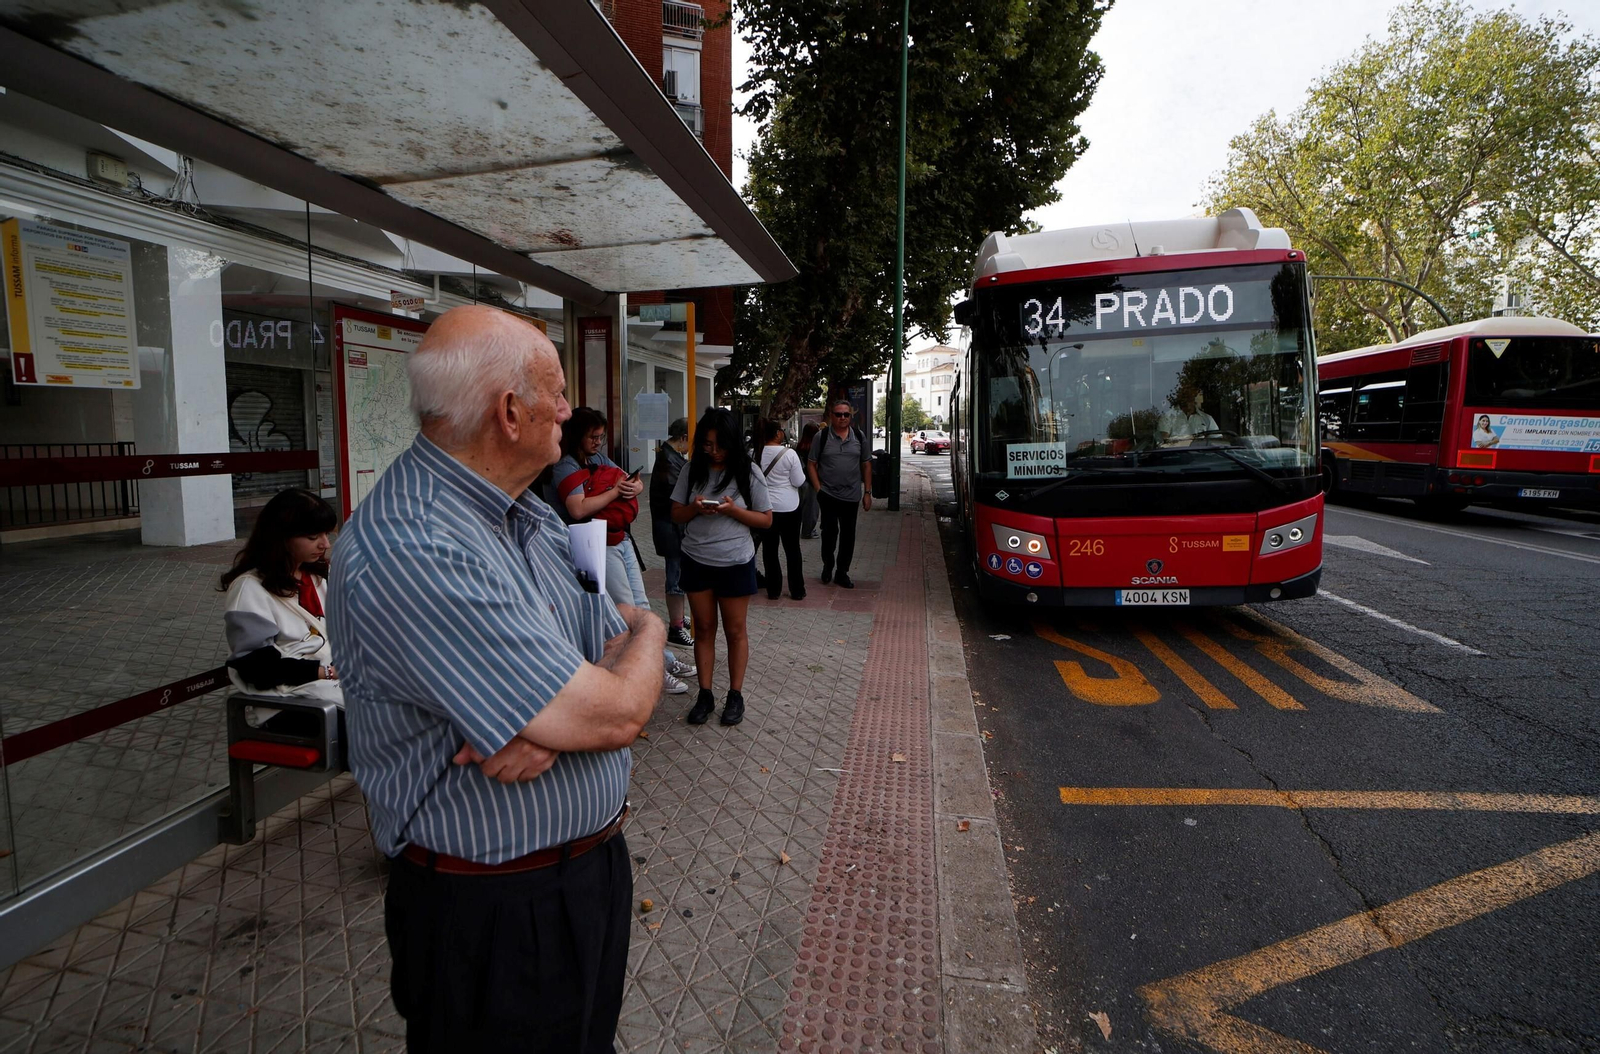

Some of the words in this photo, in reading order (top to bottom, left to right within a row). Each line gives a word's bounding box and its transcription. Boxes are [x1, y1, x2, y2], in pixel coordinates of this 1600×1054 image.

[10, 234, 20, 264] informa
[12, 265, 23, 299] TUSSAM
[403, 298, 414, 306] 010
[1023, 296, 1065, 336] 34
[1095, 284, 1234, 330] PRADO
[353, 324, 376, 335] TUSSAM
[1540, 438, 1555, 446] 954
[1556, 439, 1570, 447] 433
[1009, 449, 1065, 462] SERVICIOS
[169, 461, 200, 470] TUSSAM
[1014, 463, 1060, 476] MÍNIMOS
[1069, 539, 1105, 557] 246
[1181, 539, 1220, 549] TUSSAM
[1131, 576, 1179, 585] SCANIA
[1124, 591, 1158, 604] 4004
[1162, 591, 1187, 604] KSN
[185, 676, 215, 694] TUSSAM
